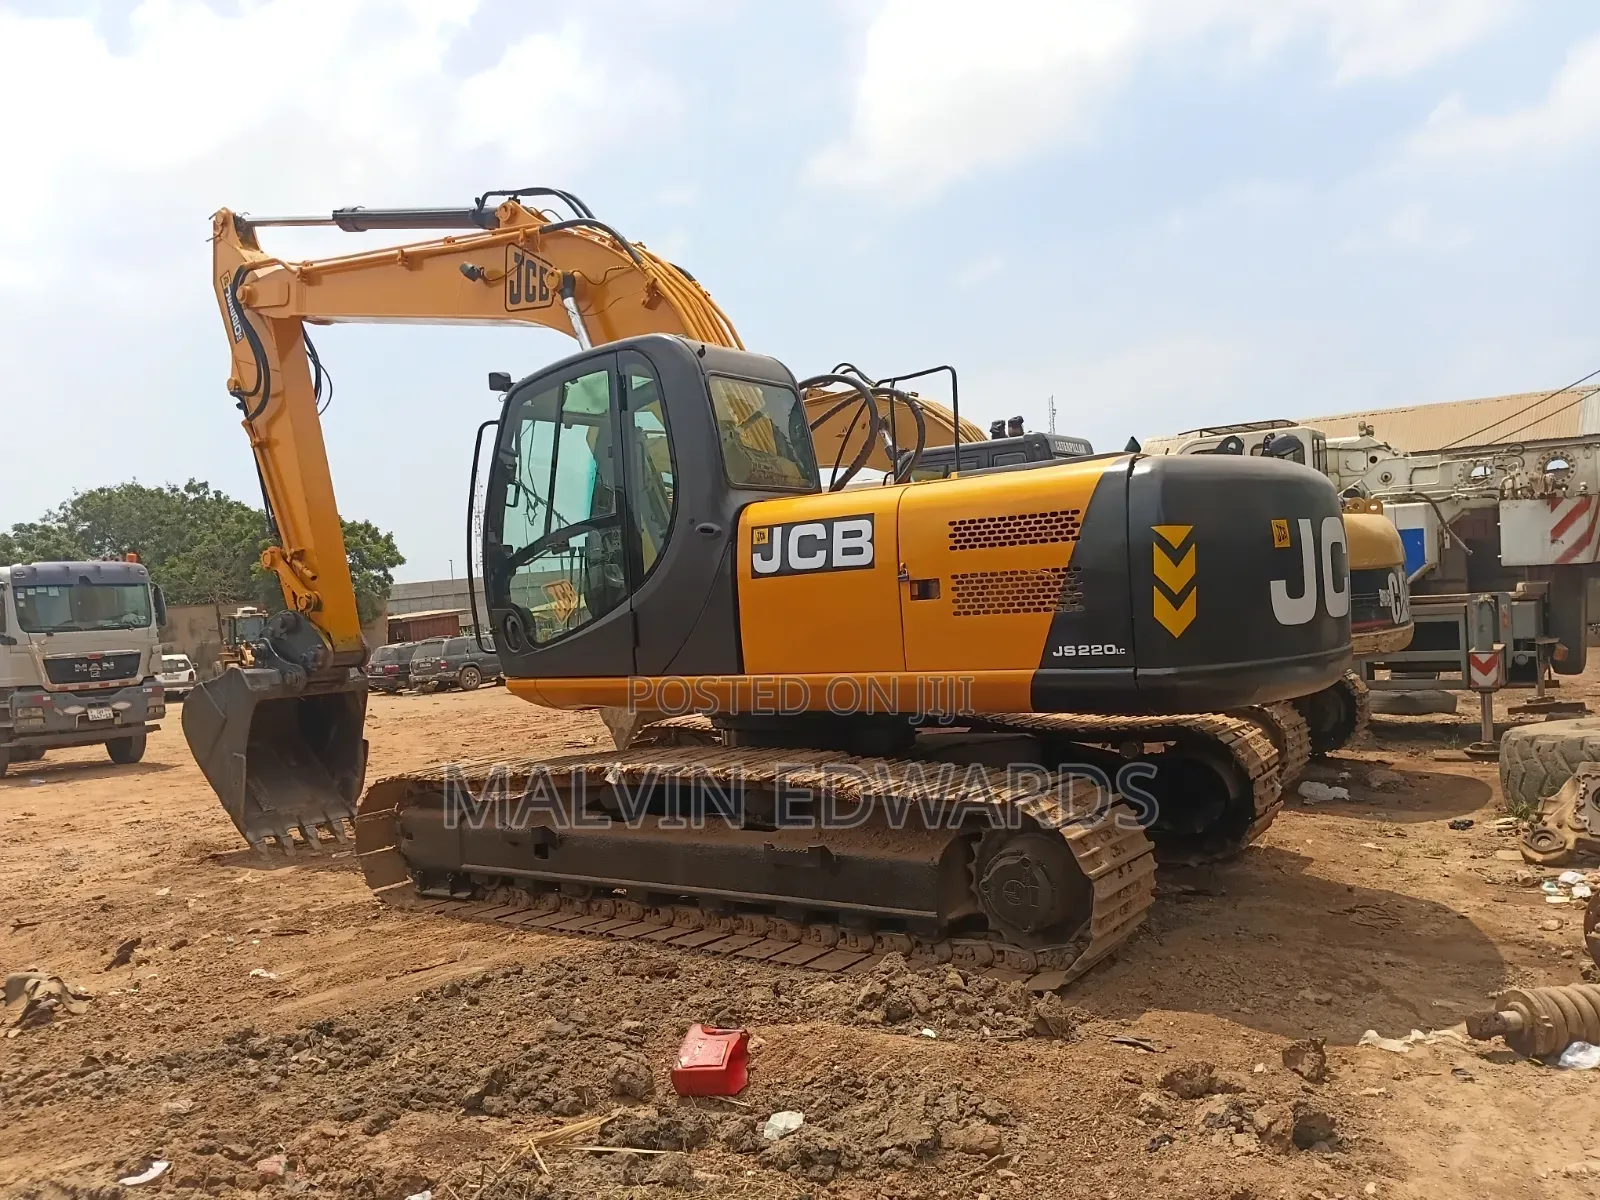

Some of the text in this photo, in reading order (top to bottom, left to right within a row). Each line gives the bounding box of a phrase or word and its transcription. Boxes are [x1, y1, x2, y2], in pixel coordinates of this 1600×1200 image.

[509, 251, 550, 305] JCB
[1054, 440, 1087, 454] CATERPILLAR
[752, 519, 874, 574] JCB
[1270, 516, 1349, 625] JC
[1387, 571, 1410, 625] CA
[75, 662, 115, 672] MAN
